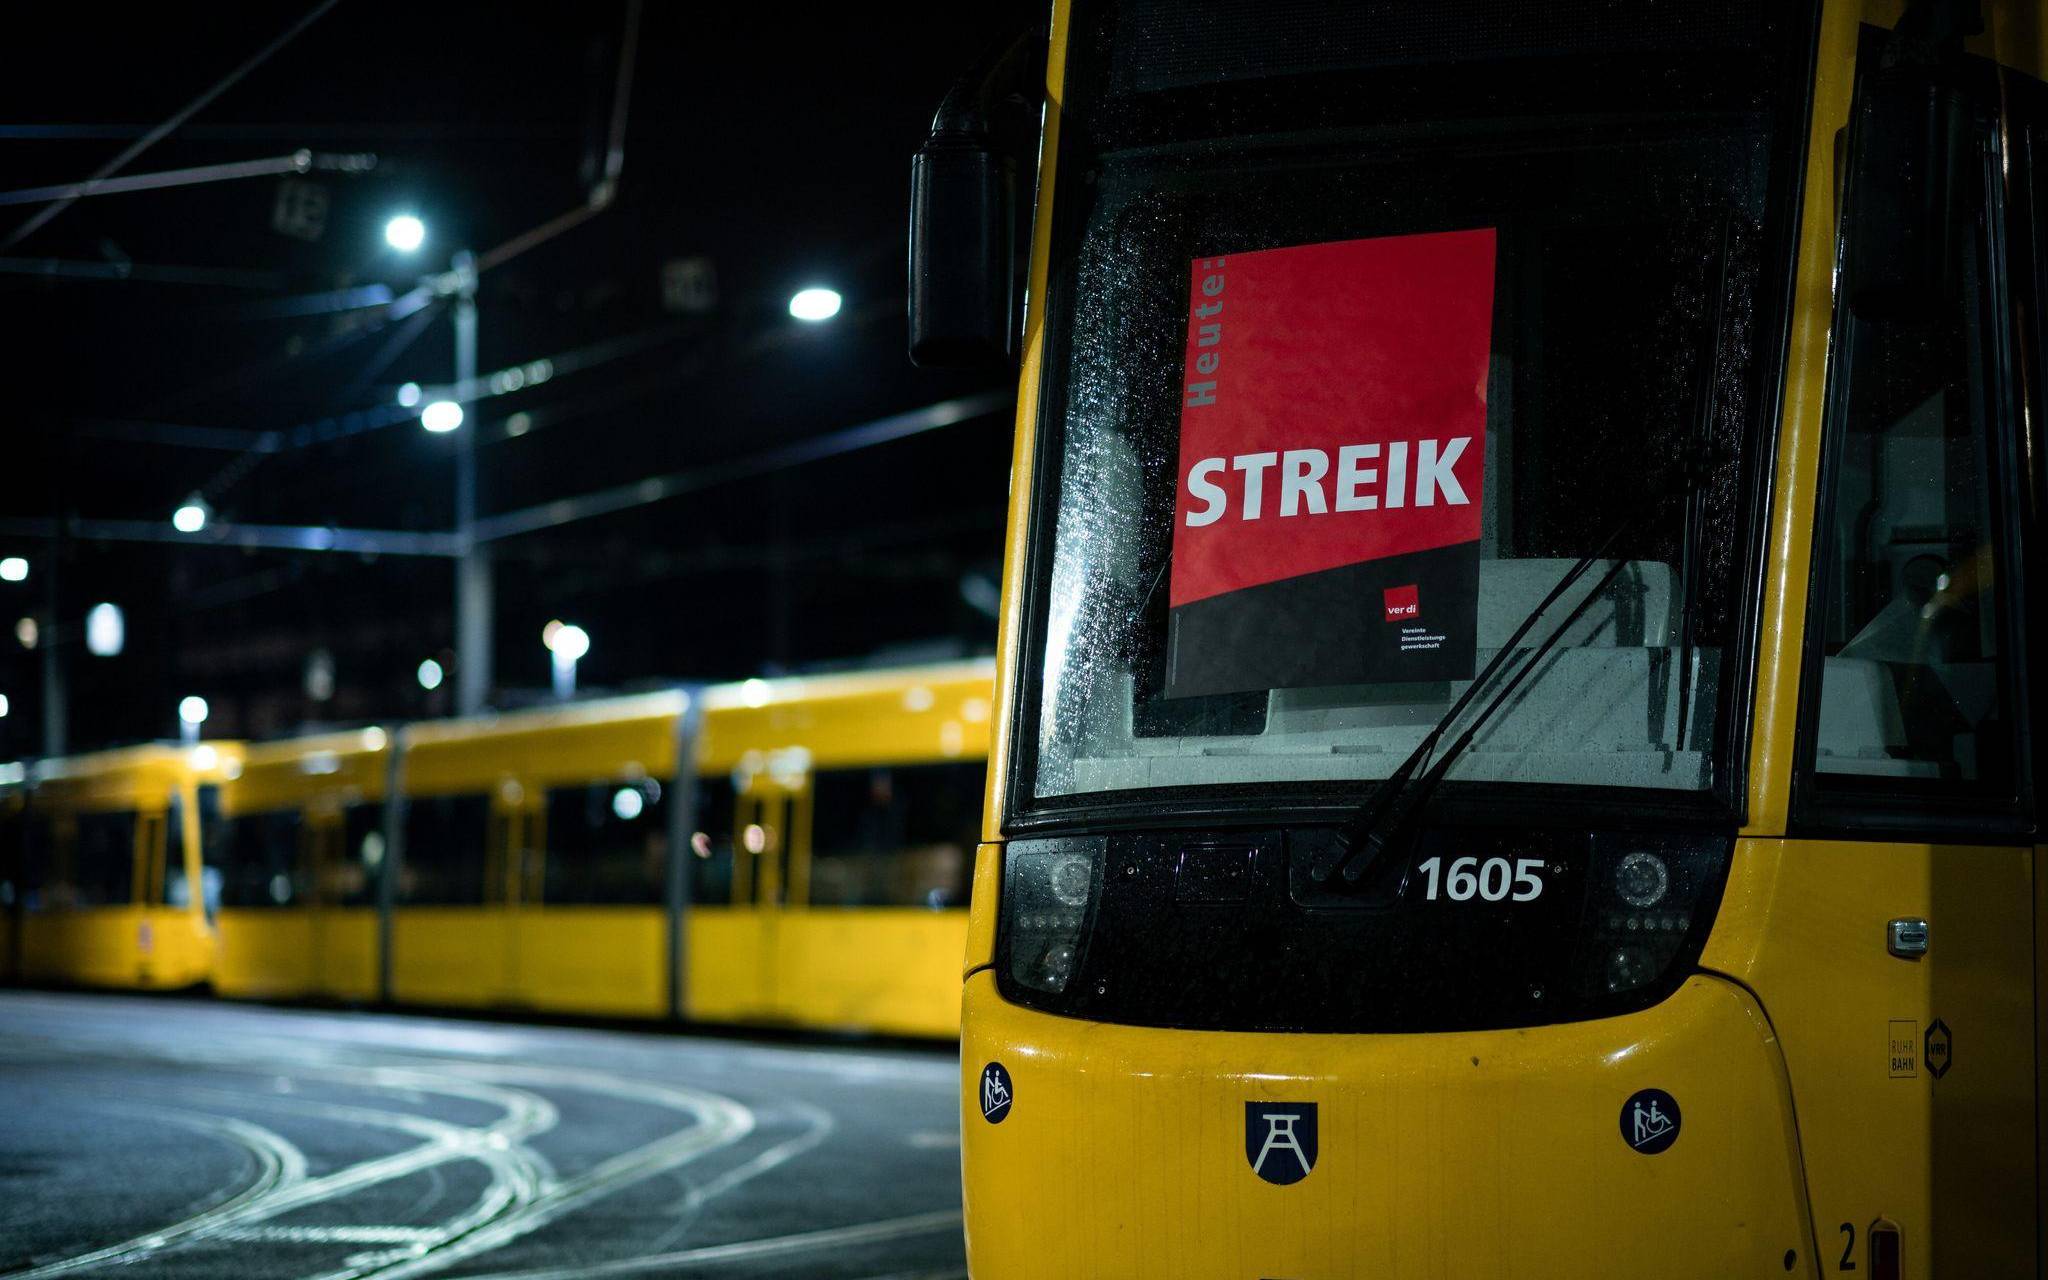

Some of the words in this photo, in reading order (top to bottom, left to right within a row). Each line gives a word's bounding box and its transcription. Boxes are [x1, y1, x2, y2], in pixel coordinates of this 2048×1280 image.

[1187, 257, 1226, 408] Heute:
[1185, 437, 1472, 527] STREIK
[1400, 642, 1440, 651] gewerkschaft
[1418, 856, 1545, 902] 1605
[1891, 1040, 1914, 1054] RUHR
[1929, 1043, 1946, 1057] VRR
[1891, 1057, 1914, 1072] BAHN
[1839, 1222, 1856, 1271] 2
